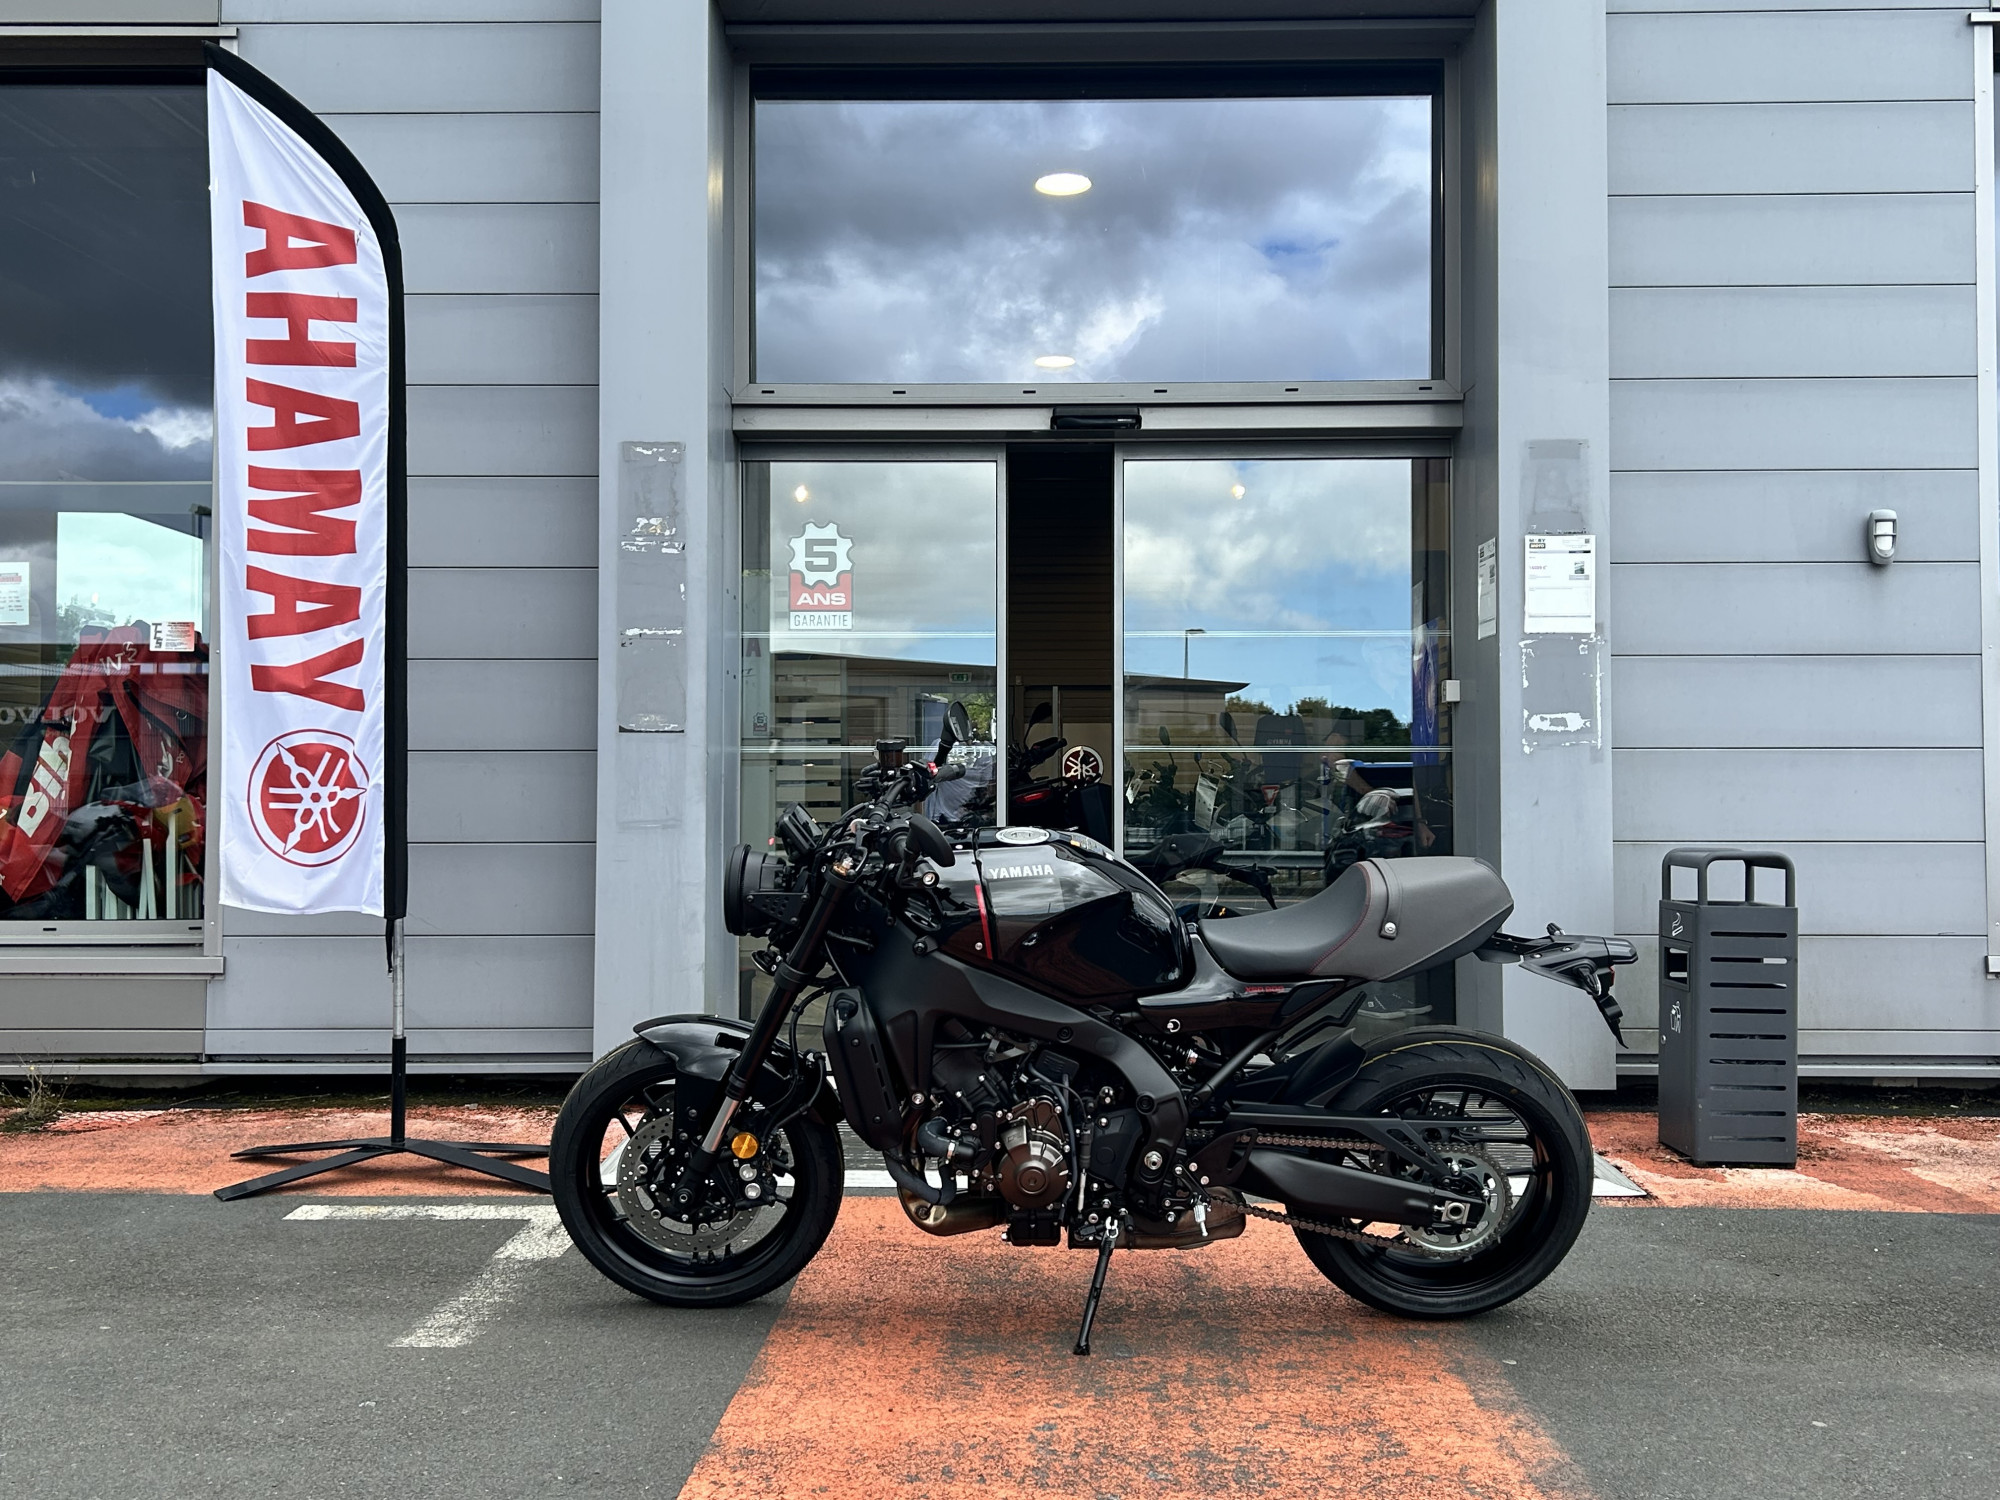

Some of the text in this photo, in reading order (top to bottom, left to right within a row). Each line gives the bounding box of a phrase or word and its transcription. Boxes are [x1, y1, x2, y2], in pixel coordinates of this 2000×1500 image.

[805, 539, 837, 572] 5
[797, 593, 846, 605] ANS
[794, 615, 848, 627] GARANTIE
[989, 864, 1054, 879] YAMAHA
